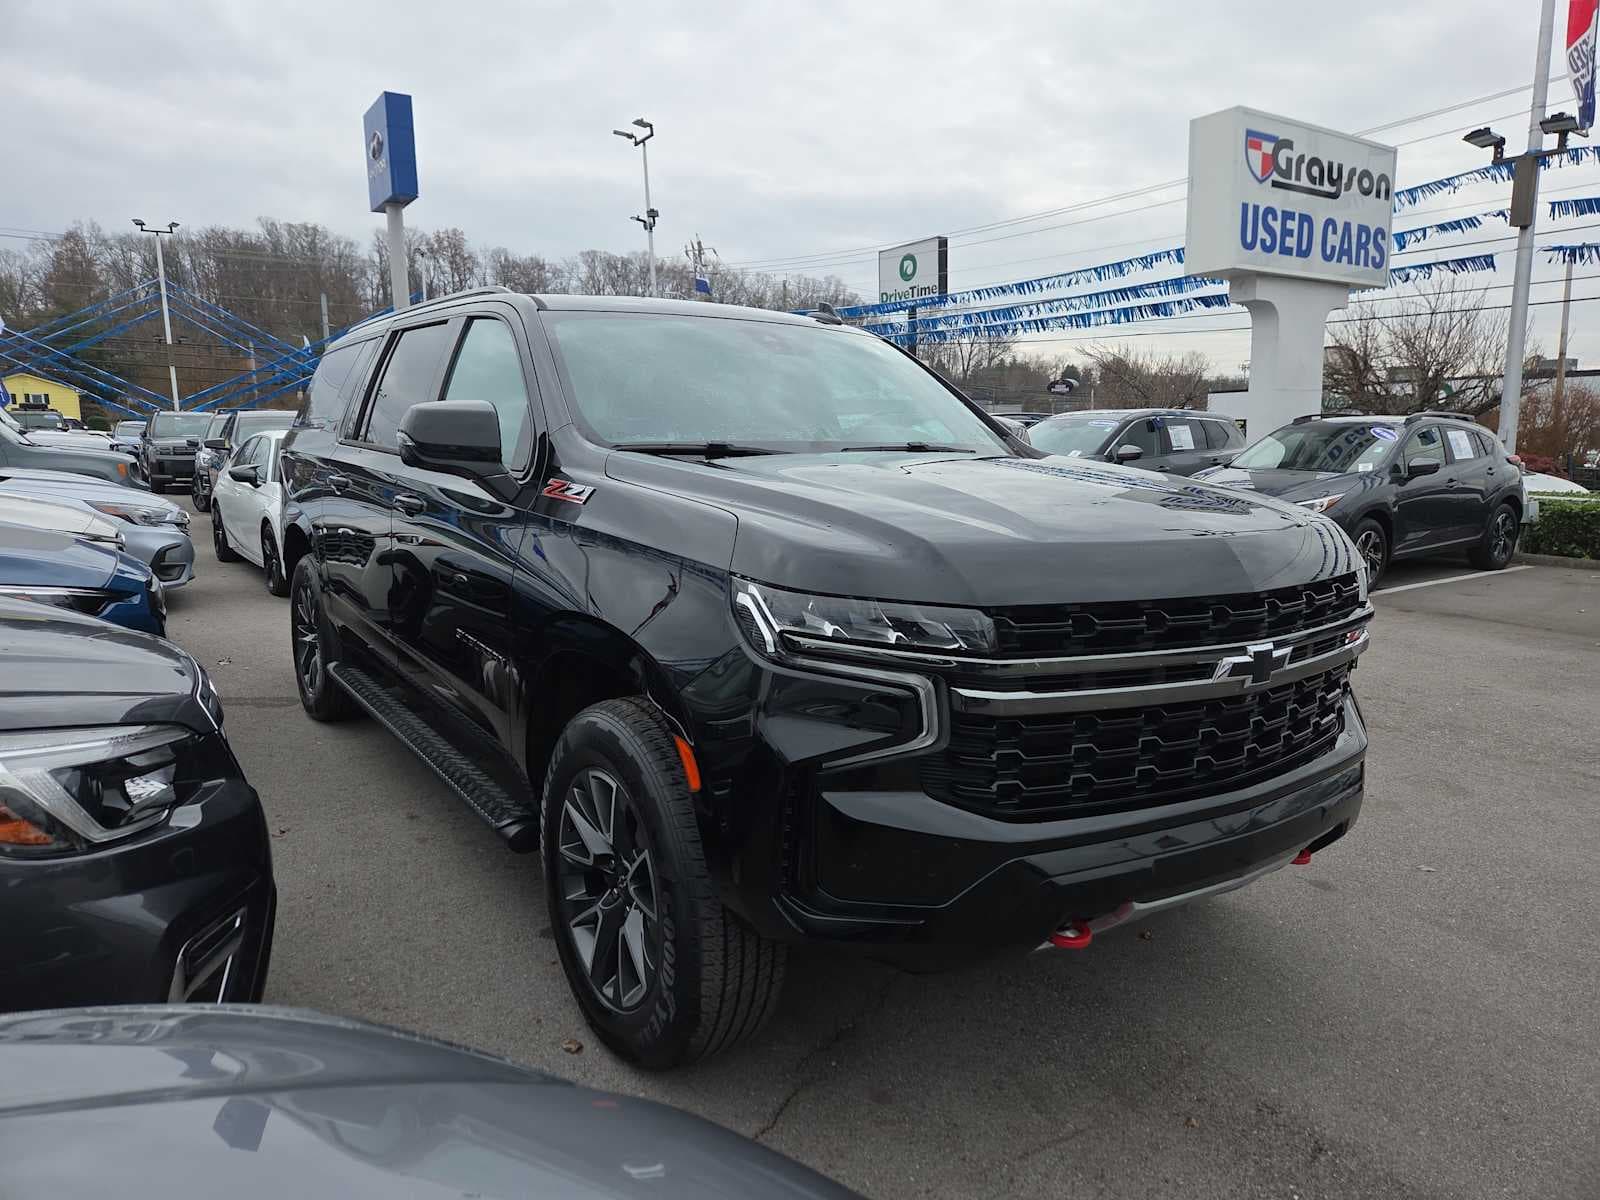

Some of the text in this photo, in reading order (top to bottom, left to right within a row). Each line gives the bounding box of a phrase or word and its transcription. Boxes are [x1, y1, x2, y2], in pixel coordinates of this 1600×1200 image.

[1272, 138, 1390, 200] Grayson
[1240, 201, 1386, 269] USED CARS
[880, 284, 938, 303] DriveTime
[543, 478, 596, 505] Z71
